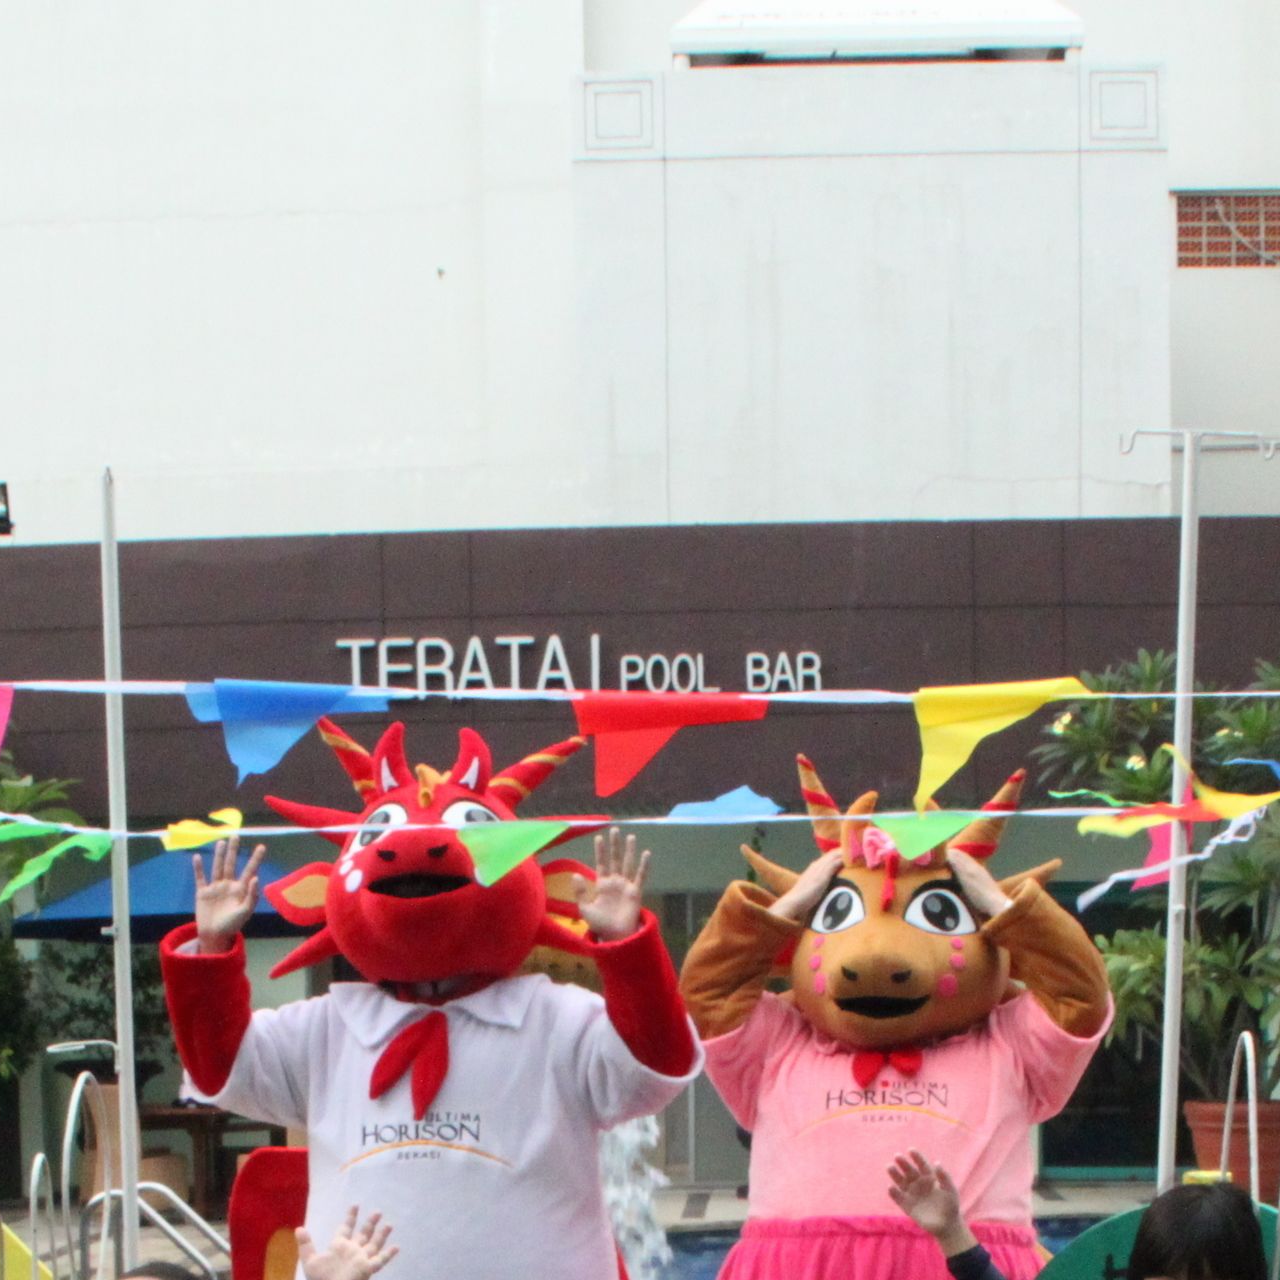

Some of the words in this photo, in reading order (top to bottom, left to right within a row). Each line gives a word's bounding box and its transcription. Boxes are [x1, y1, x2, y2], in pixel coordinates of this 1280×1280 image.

[335, 634, 600, 699] TERATAI
[620, 653, 720, 693] POOL
[746, 652, 821, 693] BAR
[825, 1089, 948, 1109] HORISON
[362, 1123, 481, 1145] HORISON
